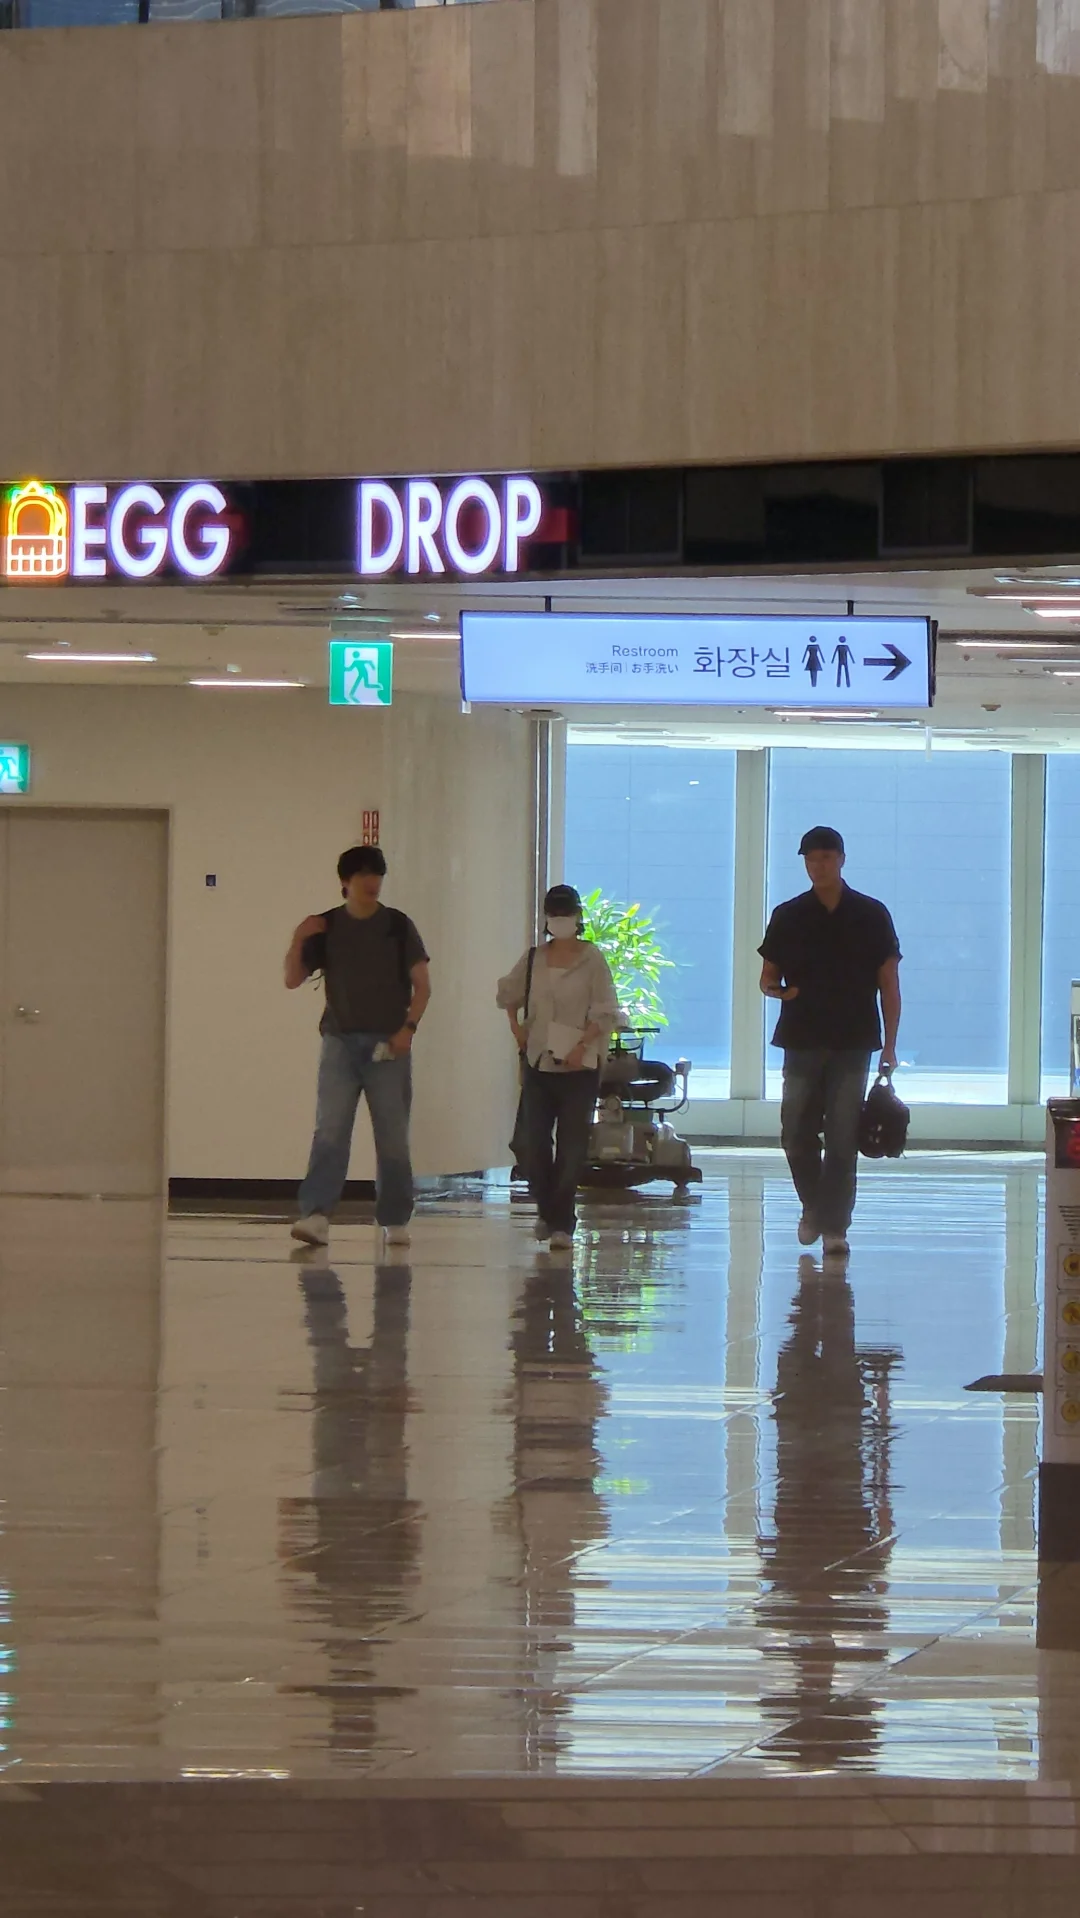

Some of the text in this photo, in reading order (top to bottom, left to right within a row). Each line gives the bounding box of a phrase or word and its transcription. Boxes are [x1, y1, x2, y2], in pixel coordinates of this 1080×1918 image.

[71, 475, 543, 578] EGG DROP
[612, 645, 679, 657] Restroom
[693, 646, 790, 677] 화장실
